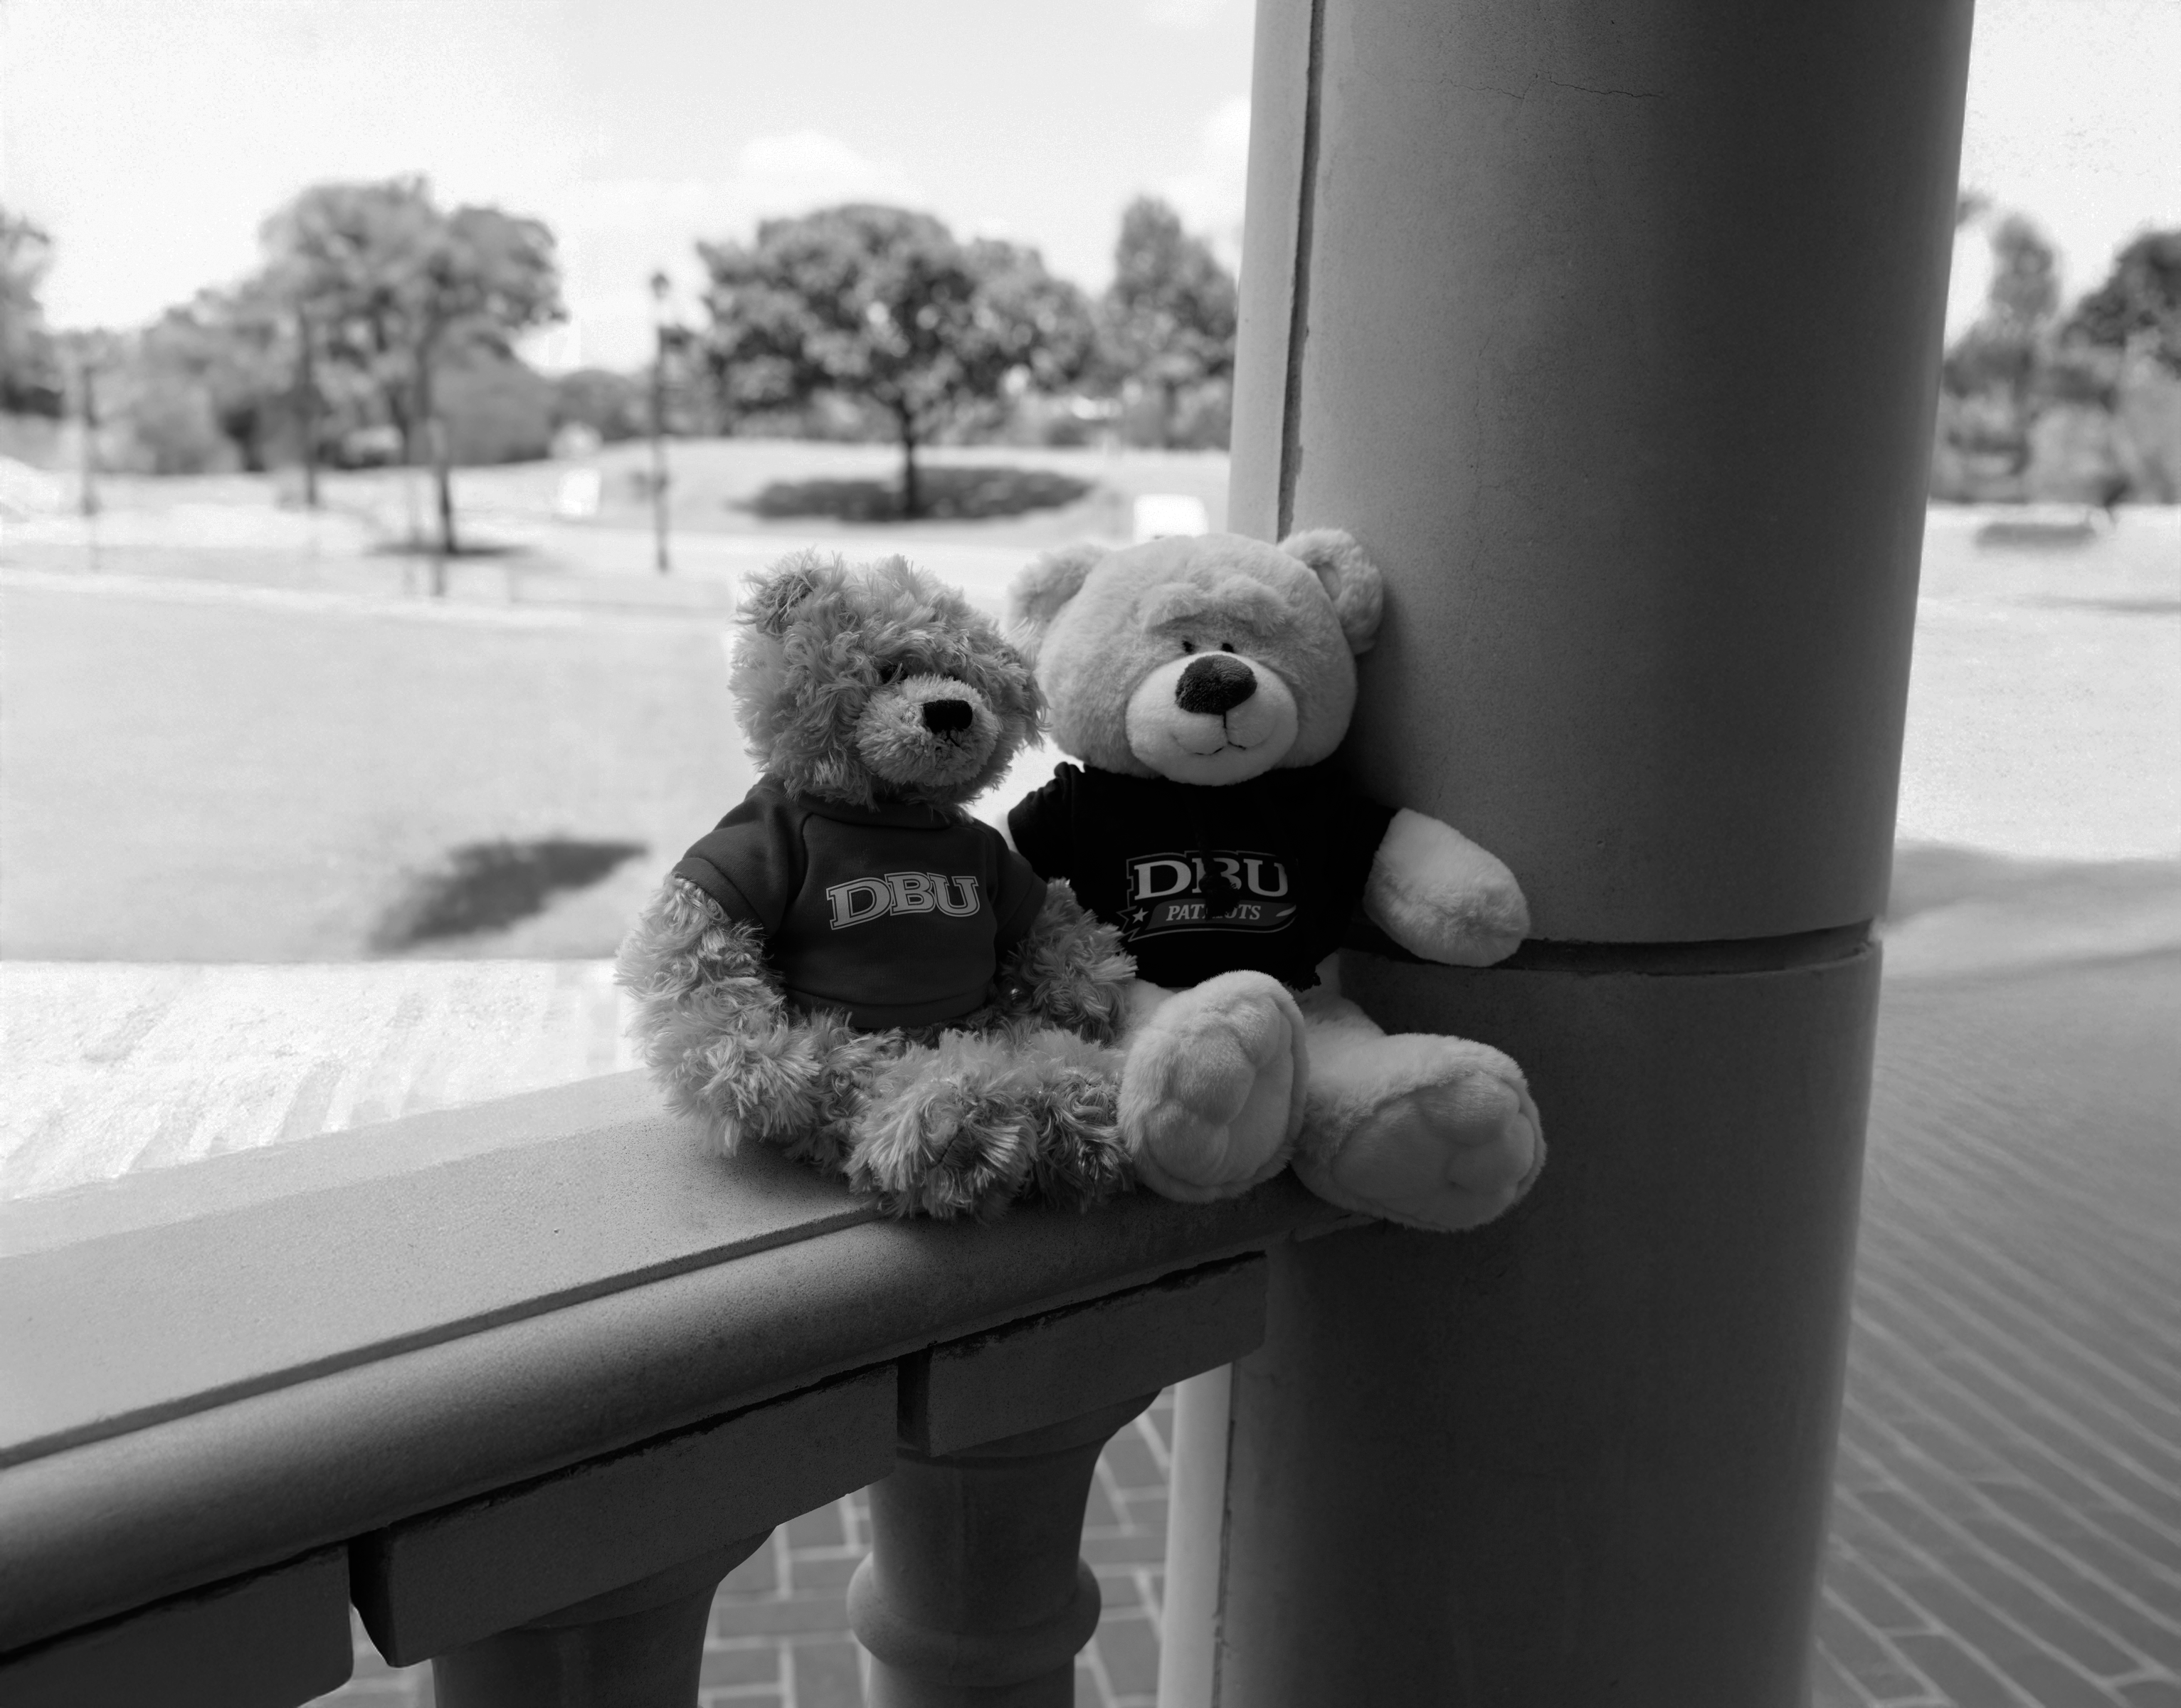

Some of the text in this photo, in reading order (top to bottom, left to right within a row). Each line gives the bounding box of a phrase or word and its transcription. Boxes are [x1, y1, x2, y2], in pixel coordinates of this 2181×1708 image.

[1134, 858, 1288, 900] DBU
[826, 872, 980, 930] DBU
[1166, 904, 1262, 922] PATOTS
